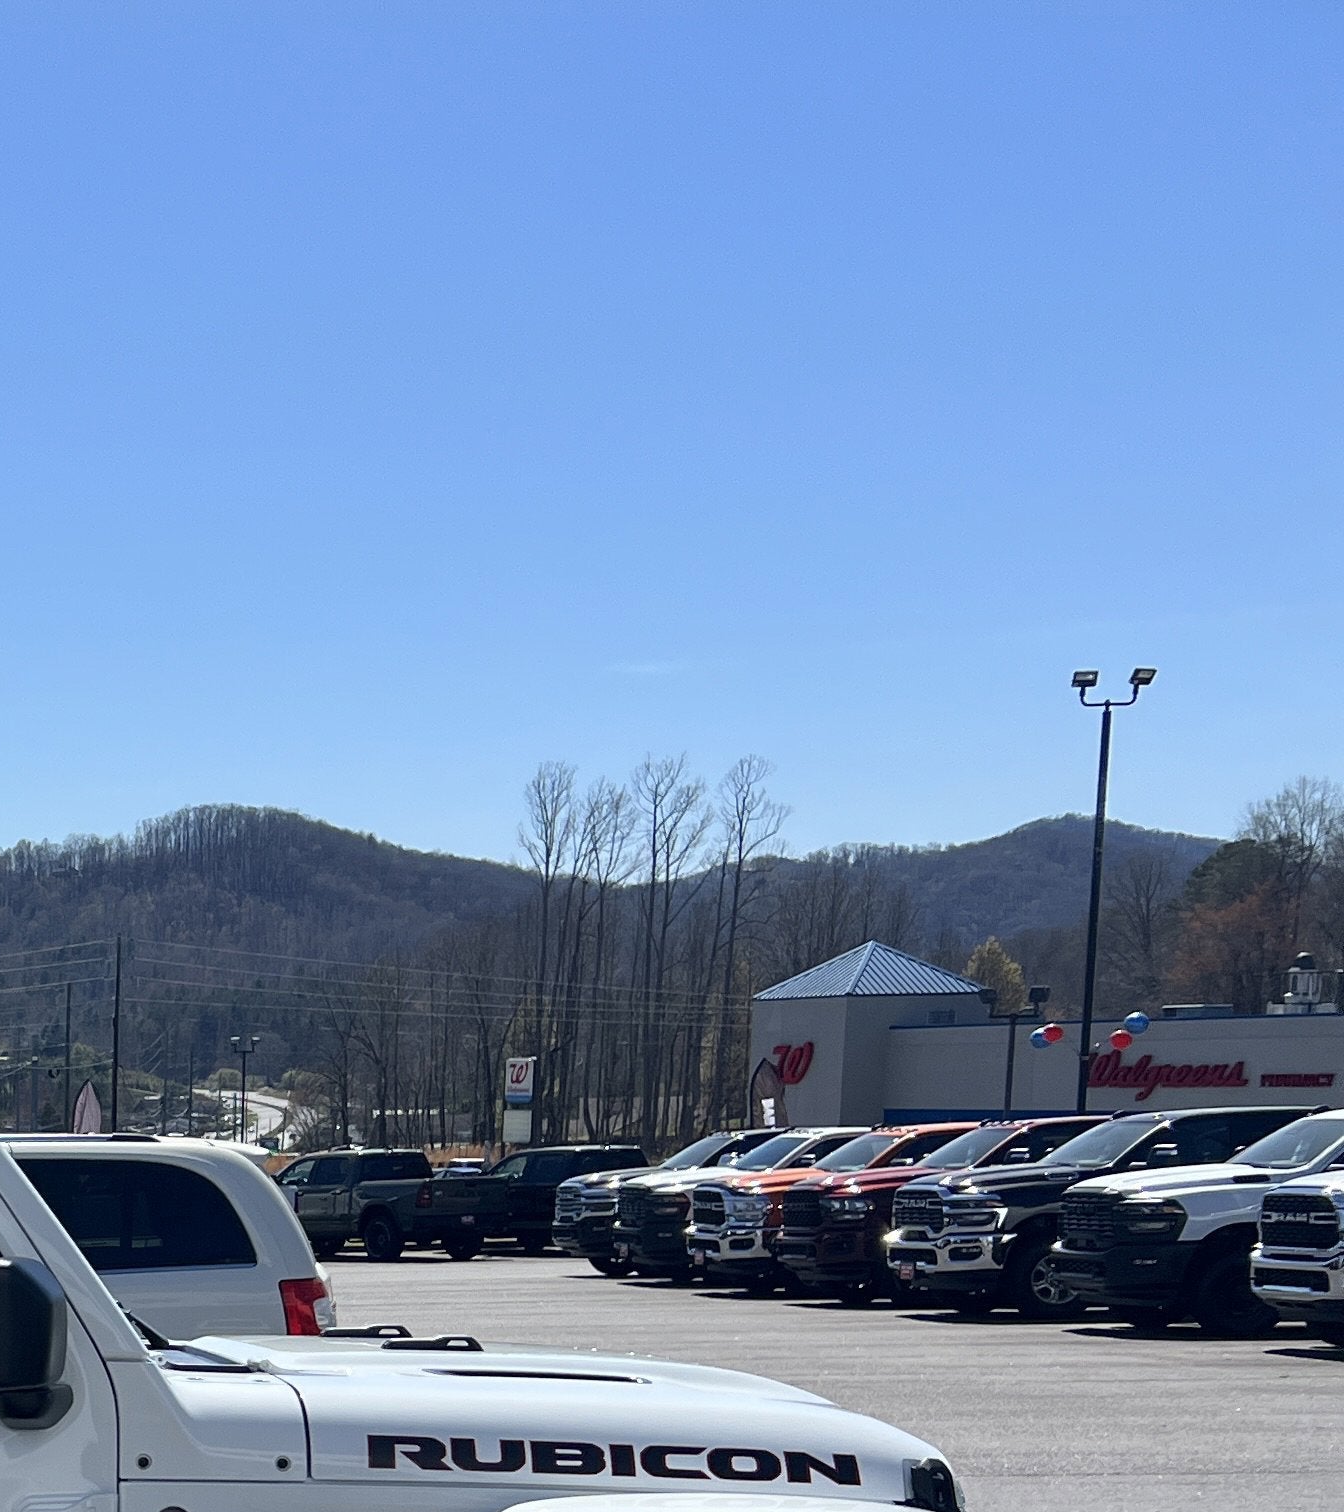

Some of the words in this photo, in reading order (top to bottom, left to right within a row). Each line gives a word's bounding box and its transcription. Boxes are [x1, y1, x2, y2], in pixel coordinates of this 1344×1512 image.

[1088, 1050, 1249, 1101] Walgreens
[1276, 1212, 1307, 1221] RAM
[367, 1434, 861, 1487] RUBICON
